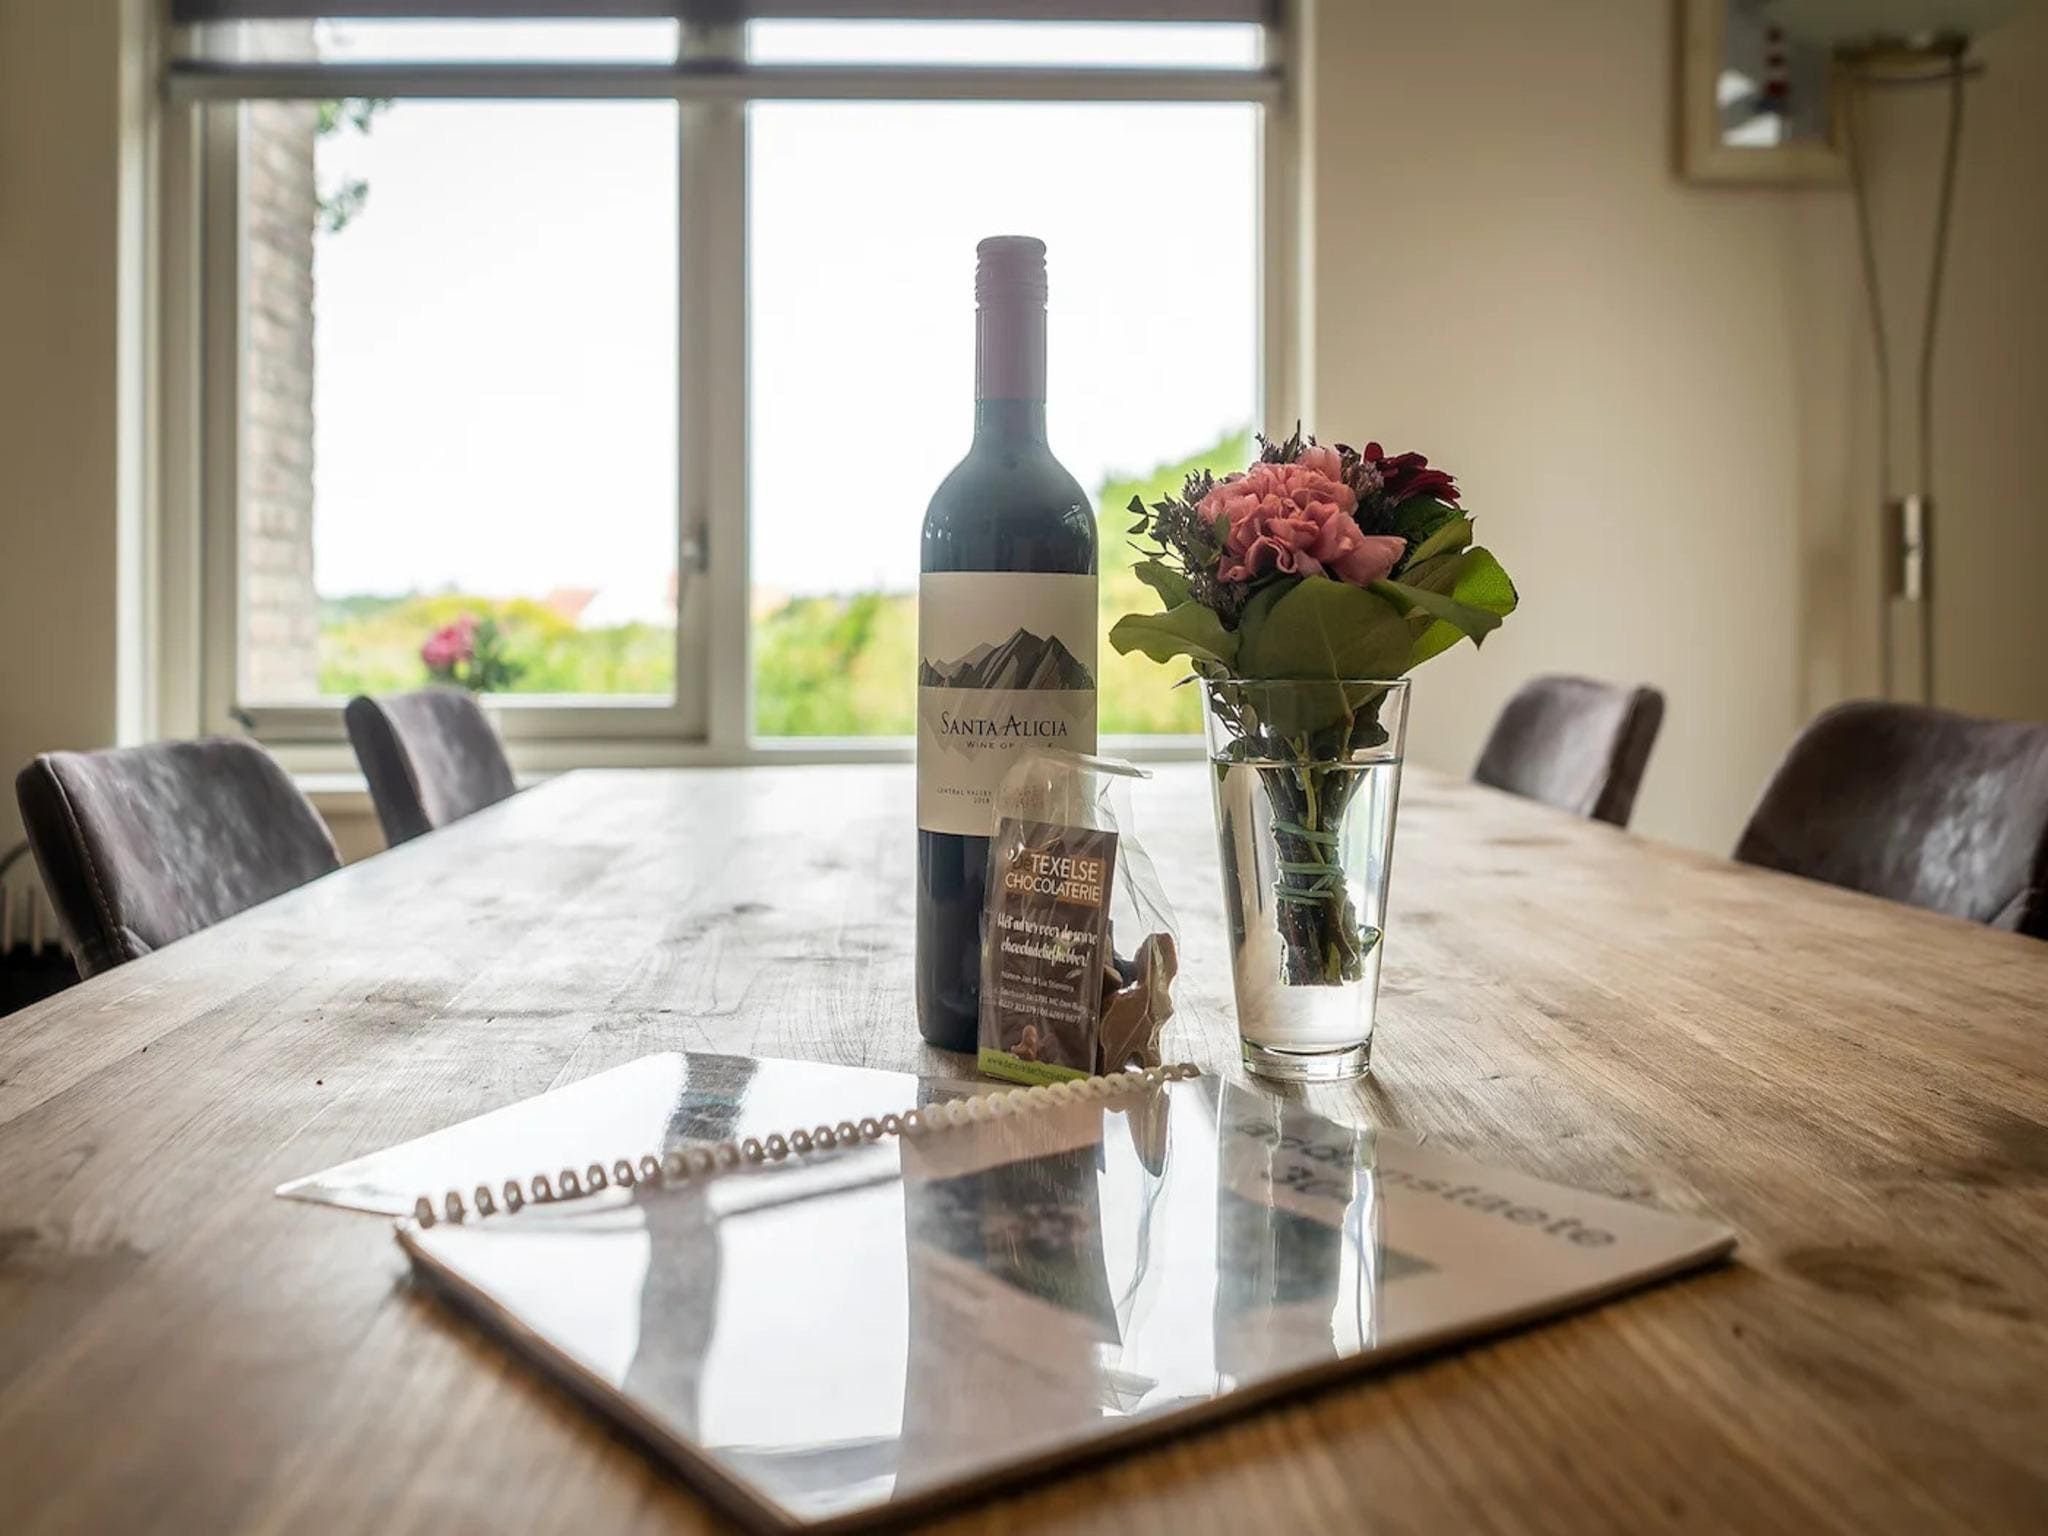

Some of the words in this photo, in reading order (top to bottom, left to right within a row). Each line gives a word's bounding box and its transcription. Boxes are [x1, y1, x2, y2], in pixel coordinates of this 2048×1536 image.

[1000, 714, 1068, 737] ALICIA
[966, 741, 994, 749] WINE
[1031, 853, 1100, 883] TEXELSE
[1004, 872, 1102, 902] CHOCOLATERIE
